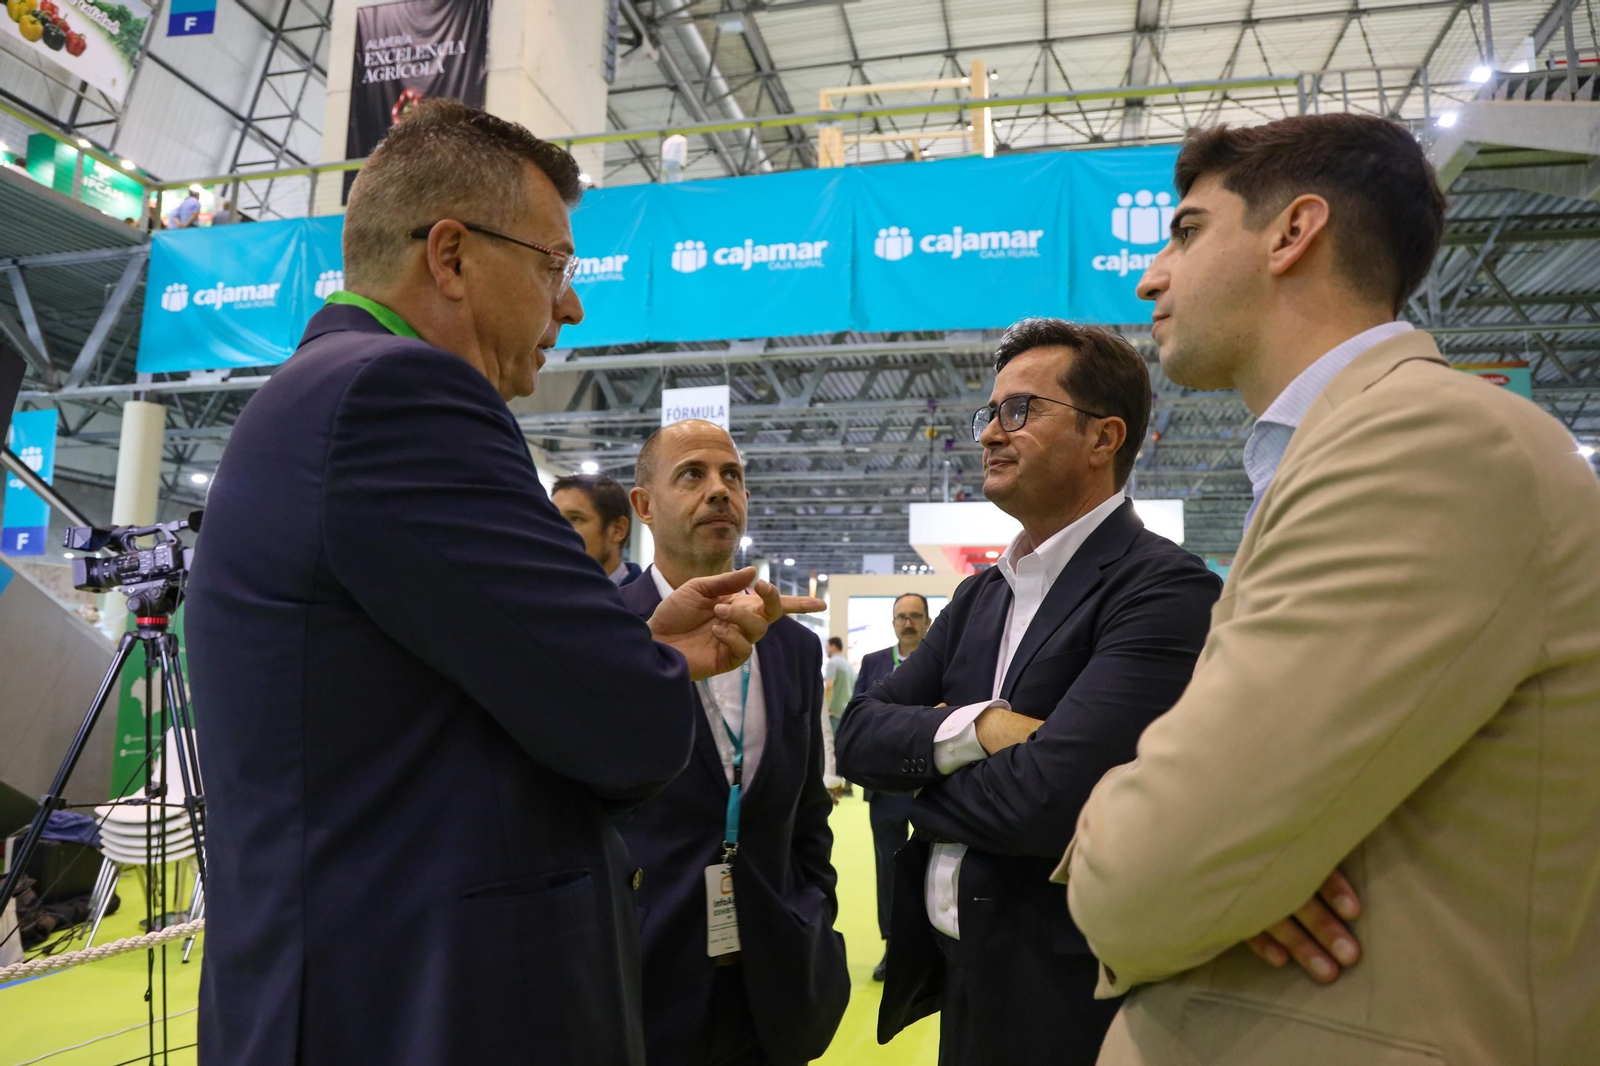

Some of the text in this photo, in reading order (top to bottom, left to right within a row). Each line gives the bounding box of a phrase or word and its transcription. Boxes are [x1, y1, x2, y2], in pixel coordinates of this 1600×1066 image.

[184, 16, 198, 32] F
[364, 40, 466, 67] EXCELENCIA
[713, 238, 828, 271] cajamar
[920, 226, 1044, 259] cajamar
[193, 281, 280, 310] cajamar
[666, 405, 725, 421] FÓRMULA
[16, 532, 30, 551] F
